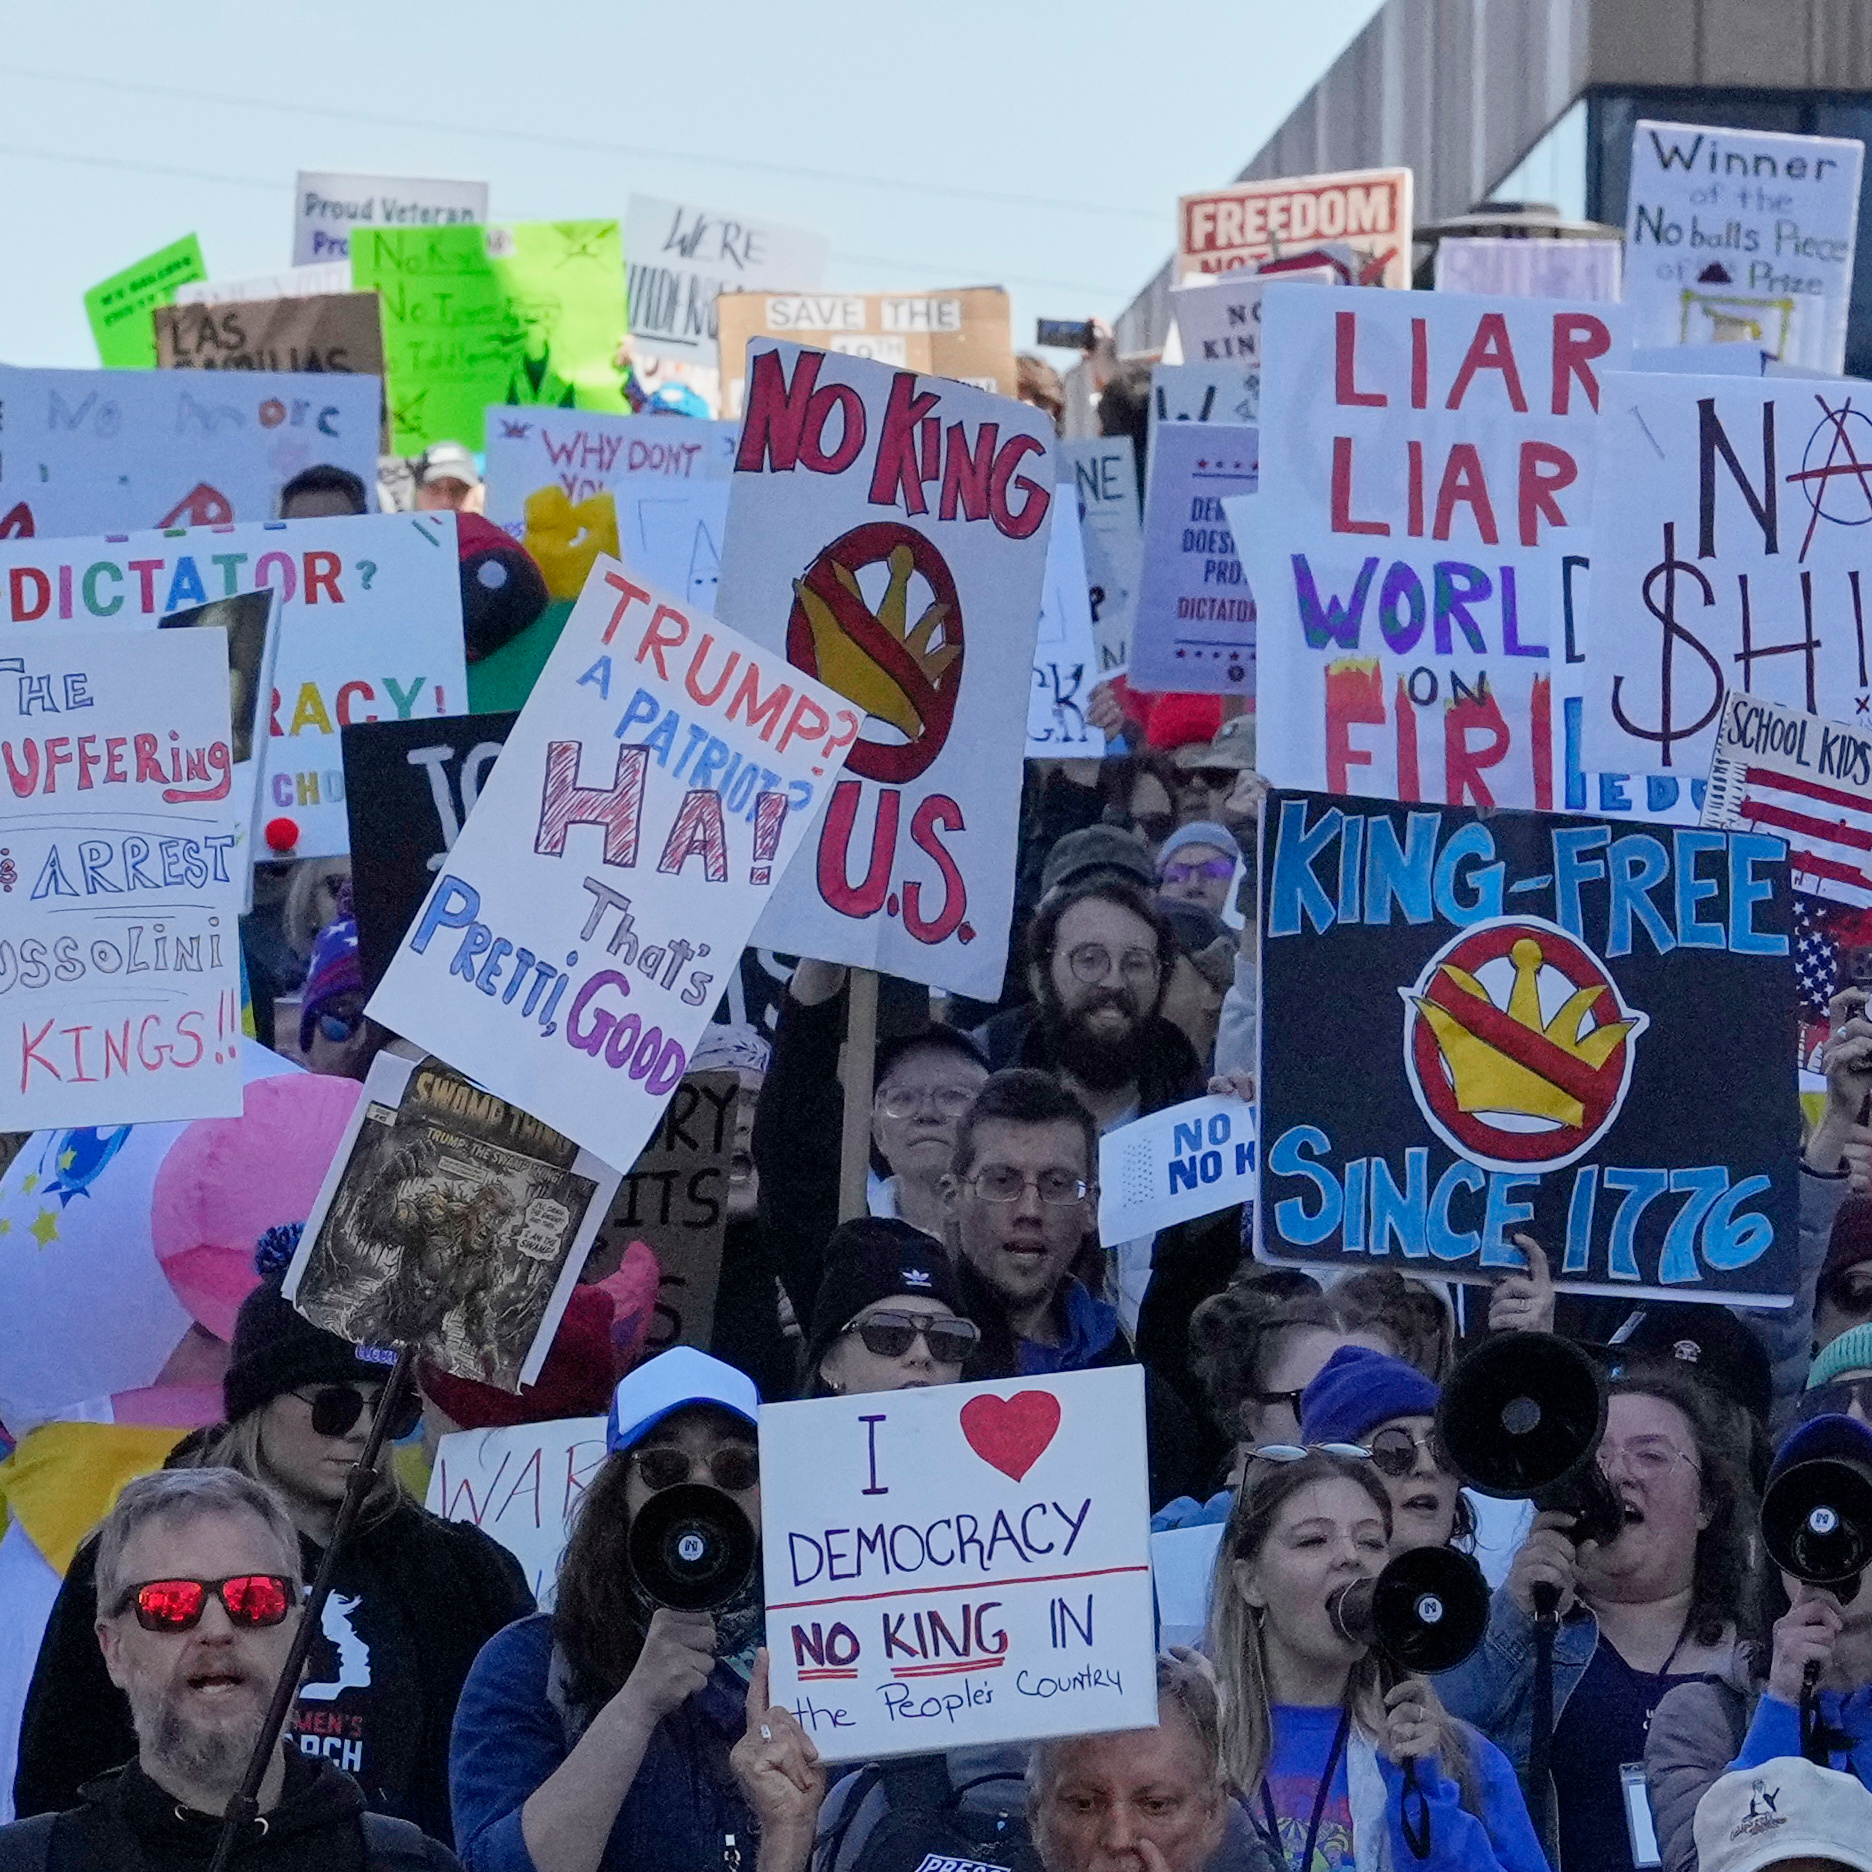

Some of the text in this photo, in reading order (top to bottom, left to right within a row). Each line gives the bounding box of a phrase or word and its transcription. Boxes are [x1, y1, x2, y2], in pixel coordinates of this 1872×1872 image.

[1649, 130, 1839, 183] Winner
[304, 193, 474, 225] Proud Veteran
[1186, 185, 1395, 254] FREEDOM
[767, 298, 959, 332] SAVE THE
[1748, 259, 1824, 297] Prize
[1333, 310, 1612, 416] LIAR
[541, 428, 622, 474] WHY
[734, 348, 1052, 541] NO KING
[1331, 436, 1579, 547] LIAR
[602, 570, 863, 778] TRUMP?
[1407, 665, 1487, 707] ON
[576, 655, 814, 823] A PATRIOT?
[1726, 699, 1810, 767] SCHOOL
[1818, 725, 1871, 787] KIDS
[533, 740, 790, 885] HA!
[30, 835, 235, 903] ARREST
[817, 780, 977, 945] U.S.
[1266, 797, 1791, 960] KING-FREE
[580, 876, 714, 1009] That's
[19, 989, 238, 1096] KINGS!!
[566, 969, 687, 1096] GOOD
[1169, 1150, 1223, 1195] NO
[1173, 1113, 1231, 1157] NO
[1267, 1124, 1775, 1286] SINCE 1776
[857, 1414, 889, 1496] I
[787, 1497, 1092, 1588] DEMOCRACY
[790, 1594, 1094, 1667] NO KING IN
[790, 1696, 856, 1730] the
[876, 1673, 993, 1726] People's
